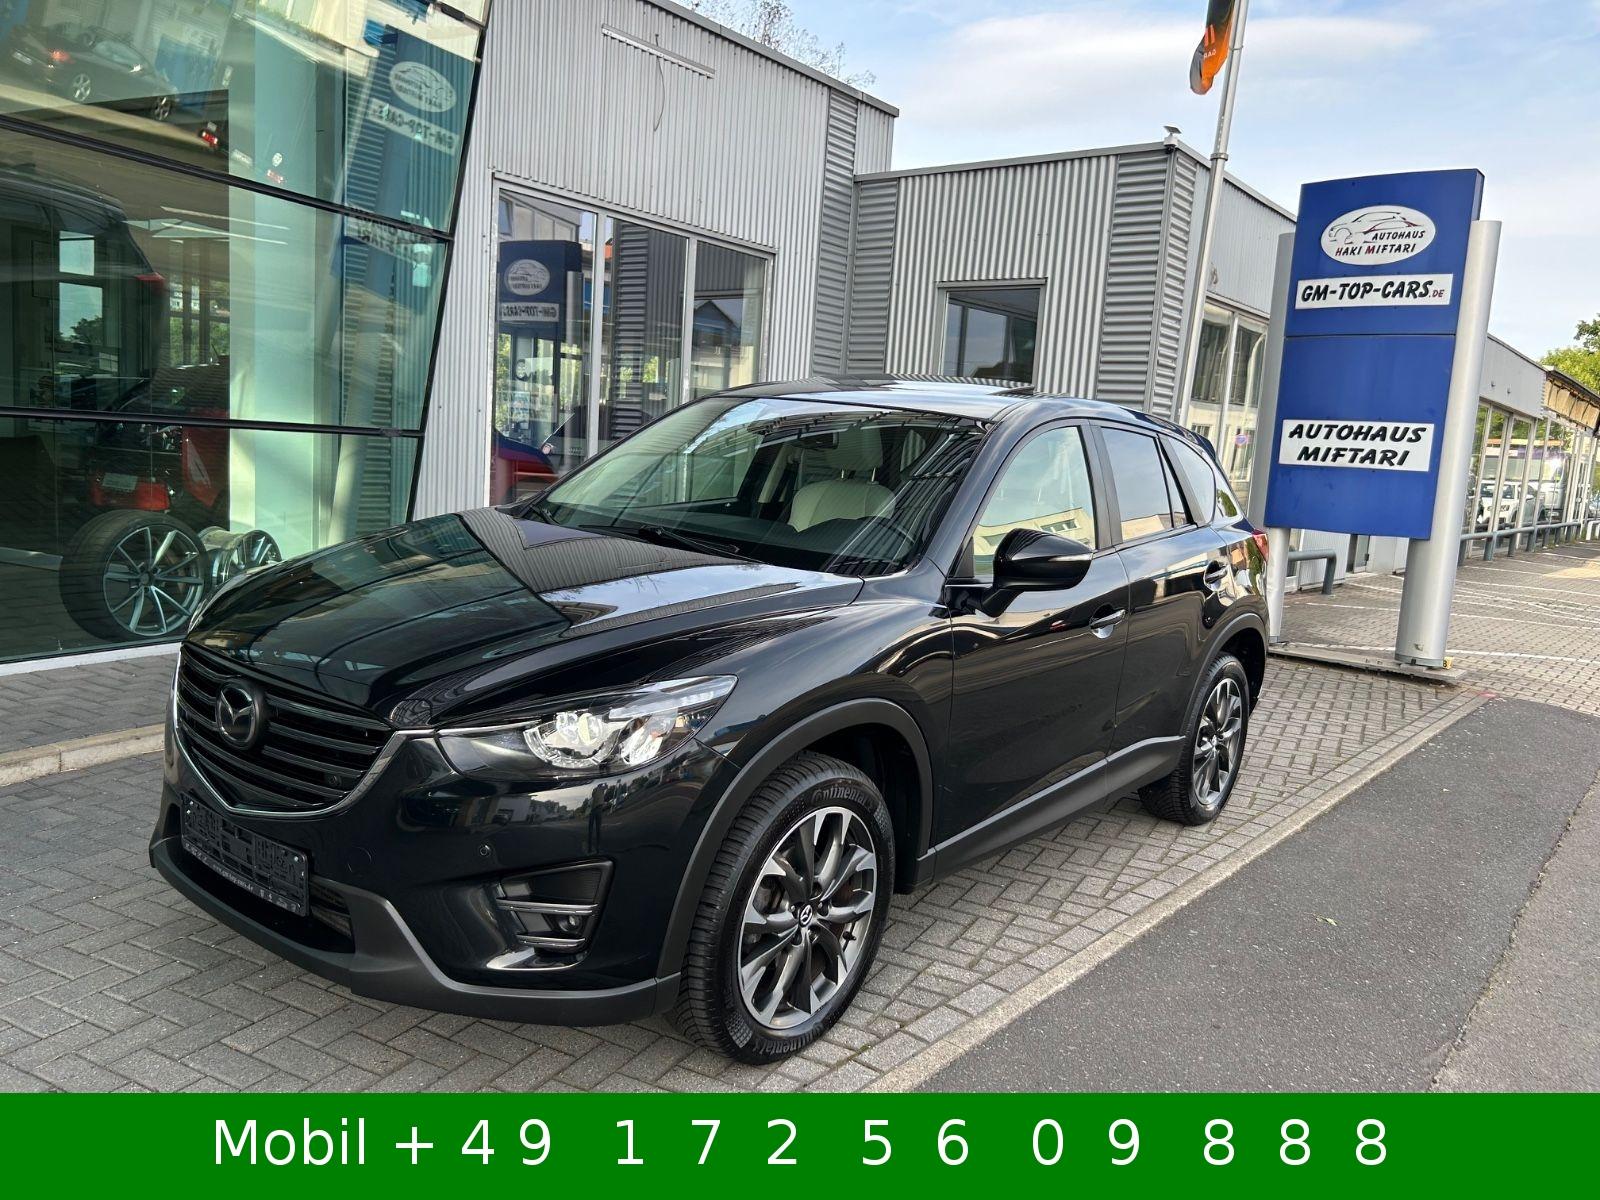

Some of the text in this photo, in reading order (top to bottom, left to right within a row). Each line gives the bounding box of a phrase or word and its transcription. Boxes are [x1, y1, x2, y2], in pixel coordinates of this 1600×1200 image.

[1372, 230, 1426, 241] AUTOHAUS
[1335, 243, 1417, 256] HAKI MIFTARI
[1301, 279, 1445, 302] GM-TOP-CARS.DE
[1288, 423, 1427, 443] AUTOHAUS
[1297, 446, 1410, 467] MIFTARI
[812, 784, 866, 805] Continental
